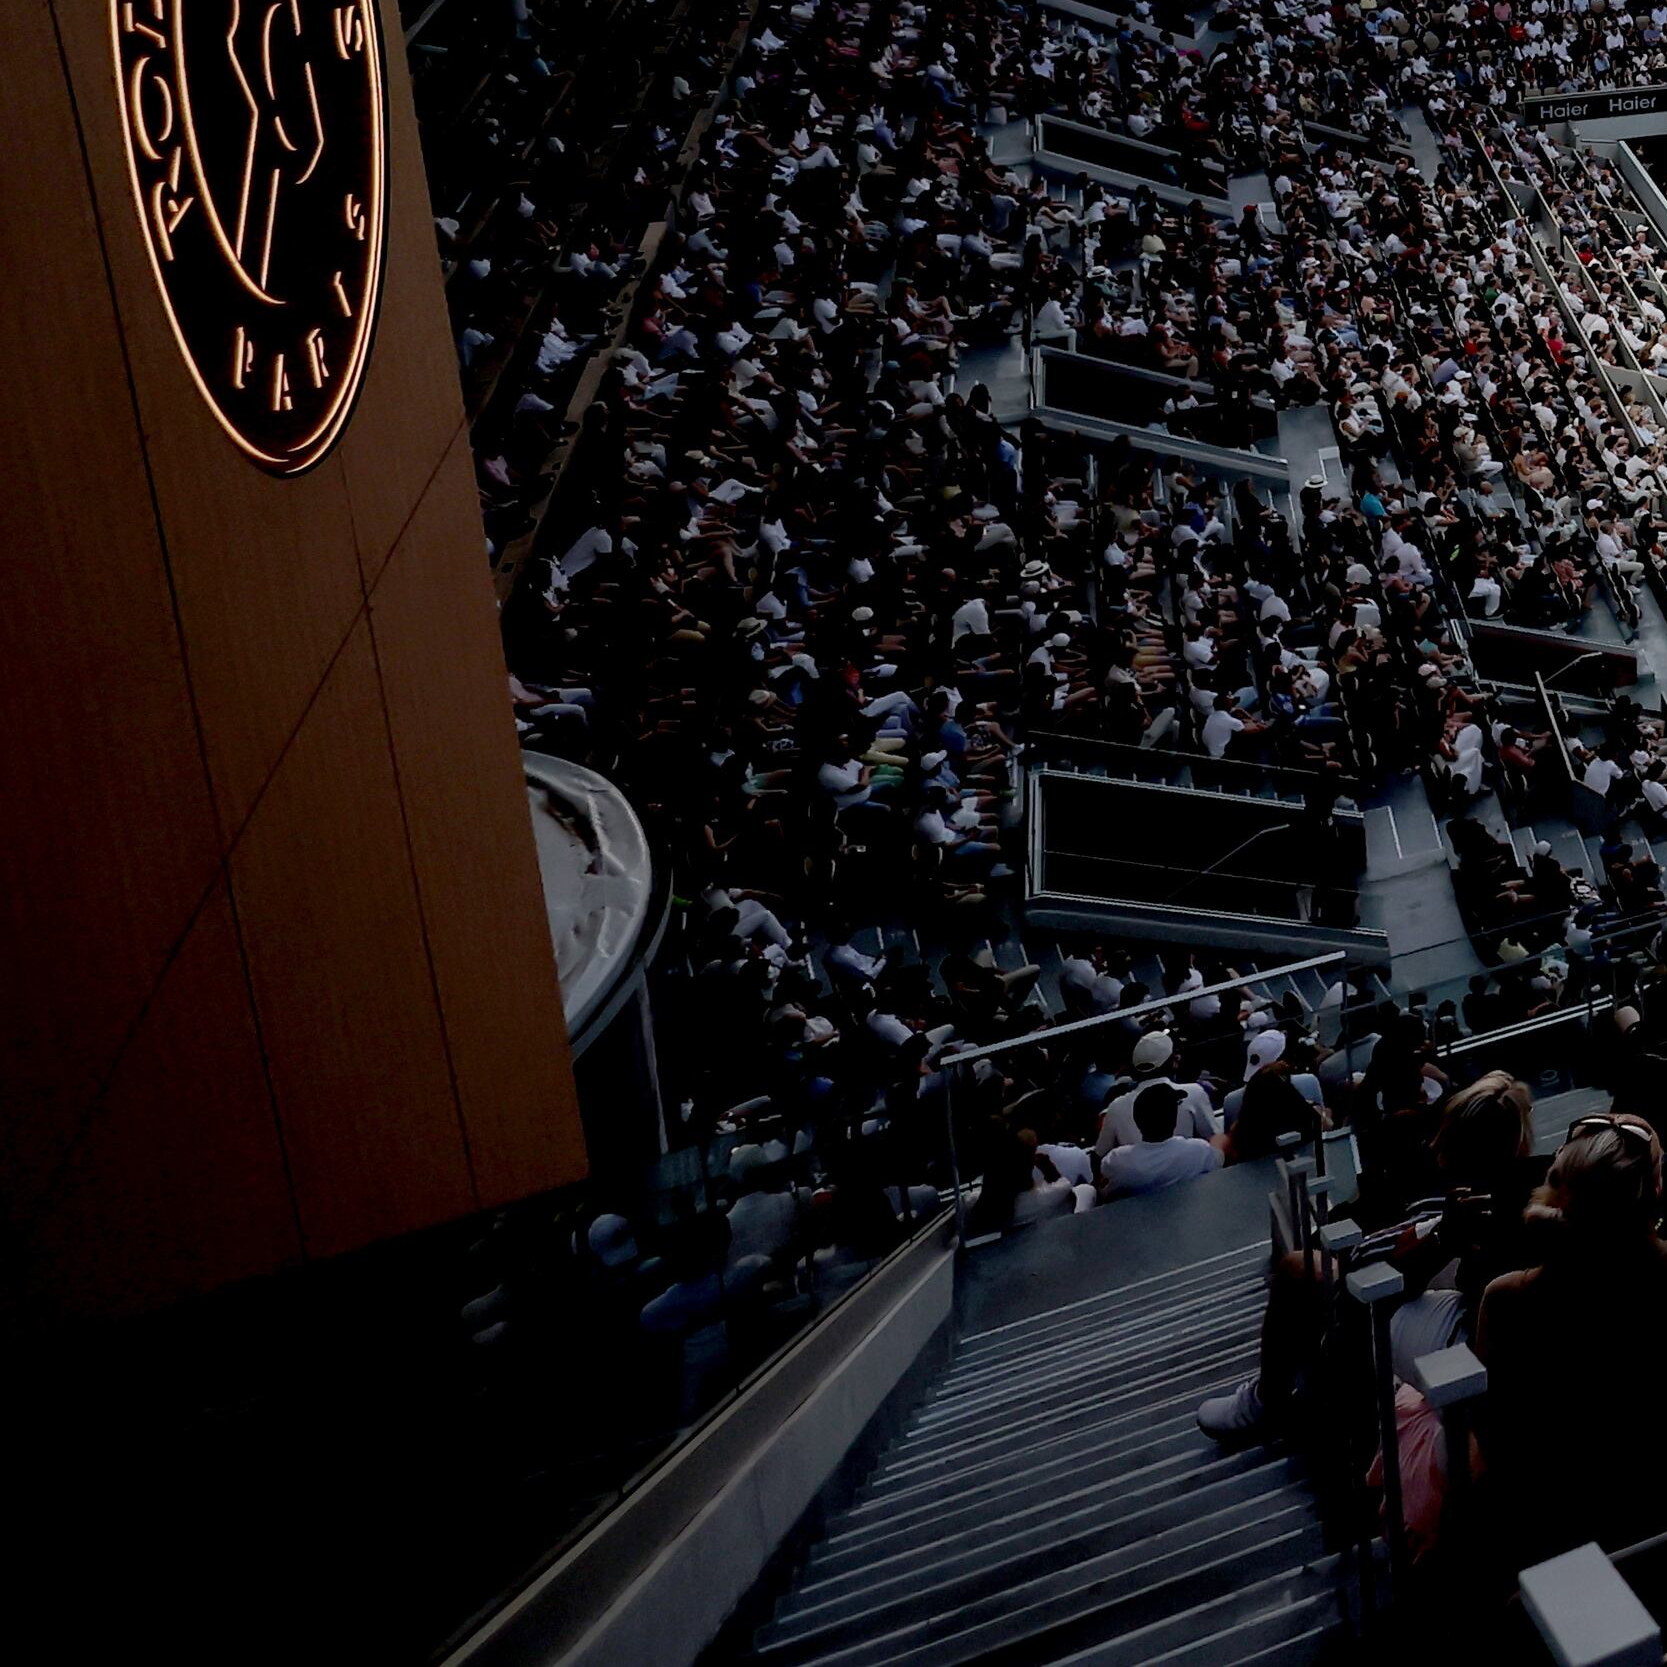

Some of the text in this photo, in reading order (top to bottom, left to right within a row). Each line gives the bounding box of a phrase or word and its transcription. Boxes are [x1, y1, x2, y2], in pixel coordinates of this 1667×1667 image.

[1540, 103, 1588, 119] Haier
[1609, 96, 1656, 112] Haier
[232, 193, 366, 411] PARIS
